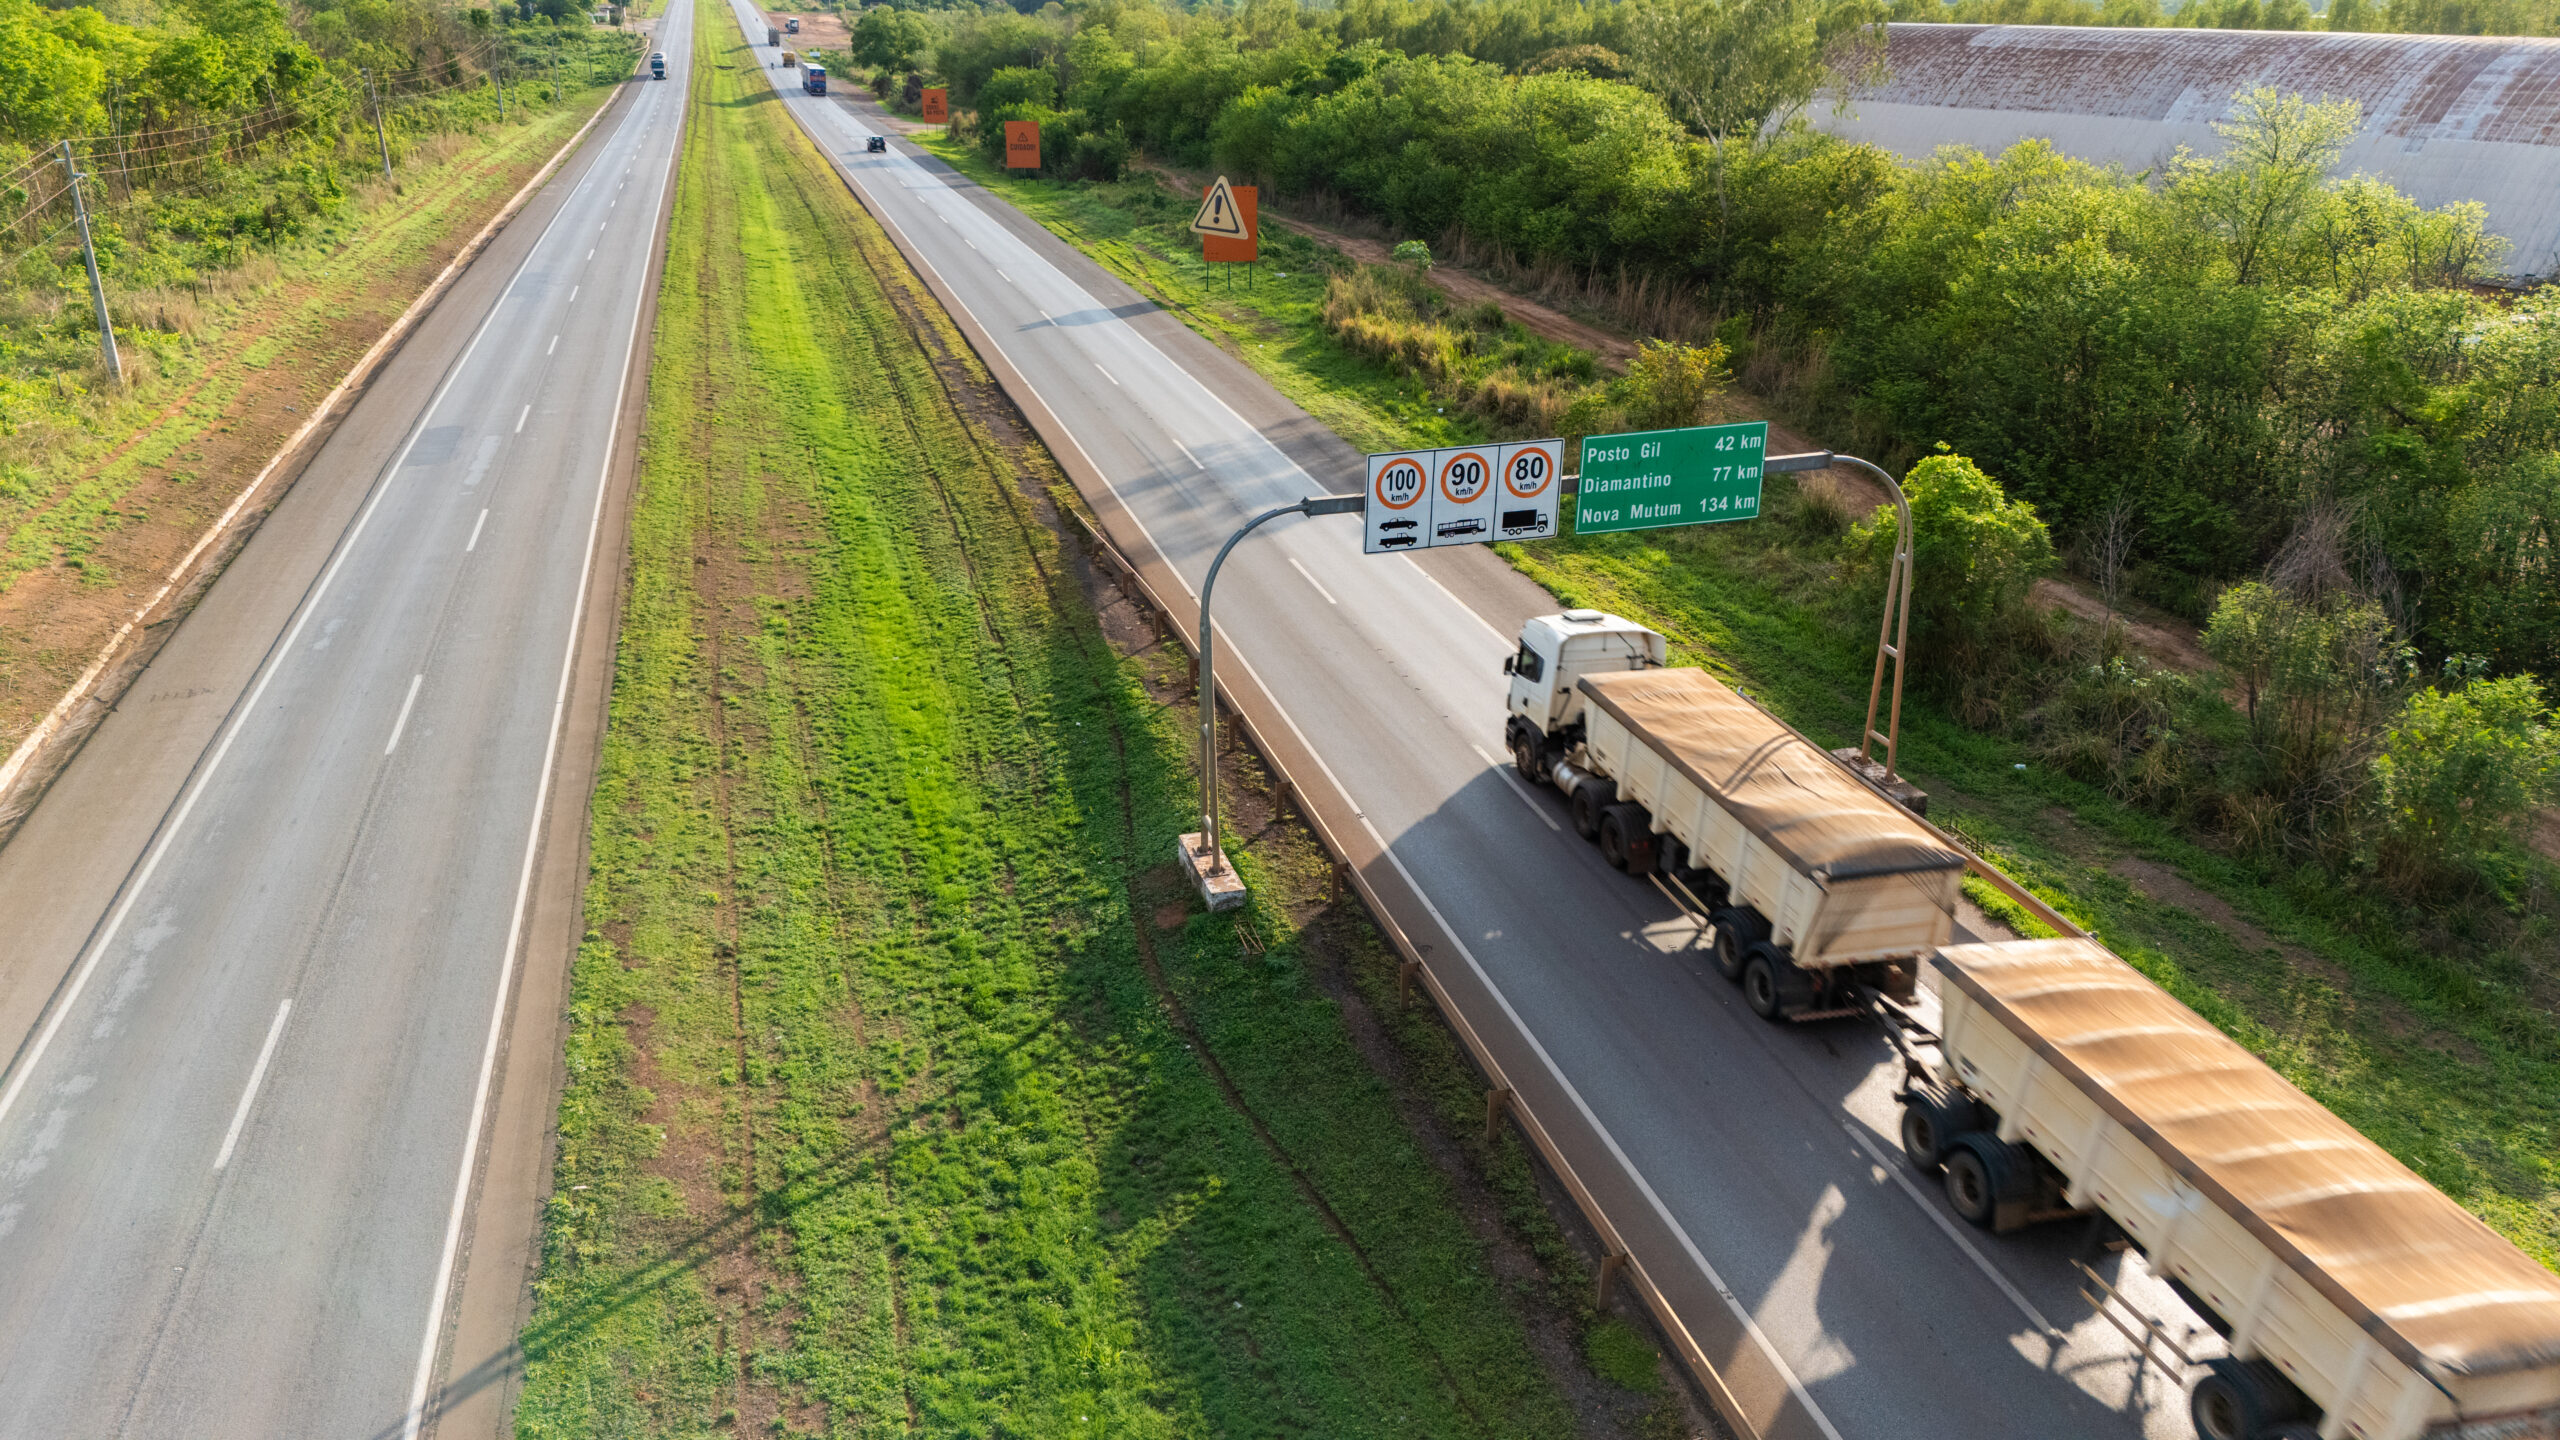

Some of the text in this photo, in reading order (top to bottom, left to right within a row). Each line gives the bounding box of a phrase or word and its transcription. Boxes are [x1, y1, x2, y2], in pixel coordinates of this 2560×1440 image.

[1587, 434, 1762, 463] Posto Gil 42 km
[1386, 468, 1416, 491] 100
[1451, 462, 1480, 486] 90
[1515, 456, 1544, 480] 80
[1584, 464, 1758, 493] Diamantino 77 km
[1391, 493, 1409, 502] km/h
[1455, 486, 1473, 496] km/h
[1519, 481, 1537, 491] km/h
[1582, 495, 1755, 524] Nova Mutum 134 km
